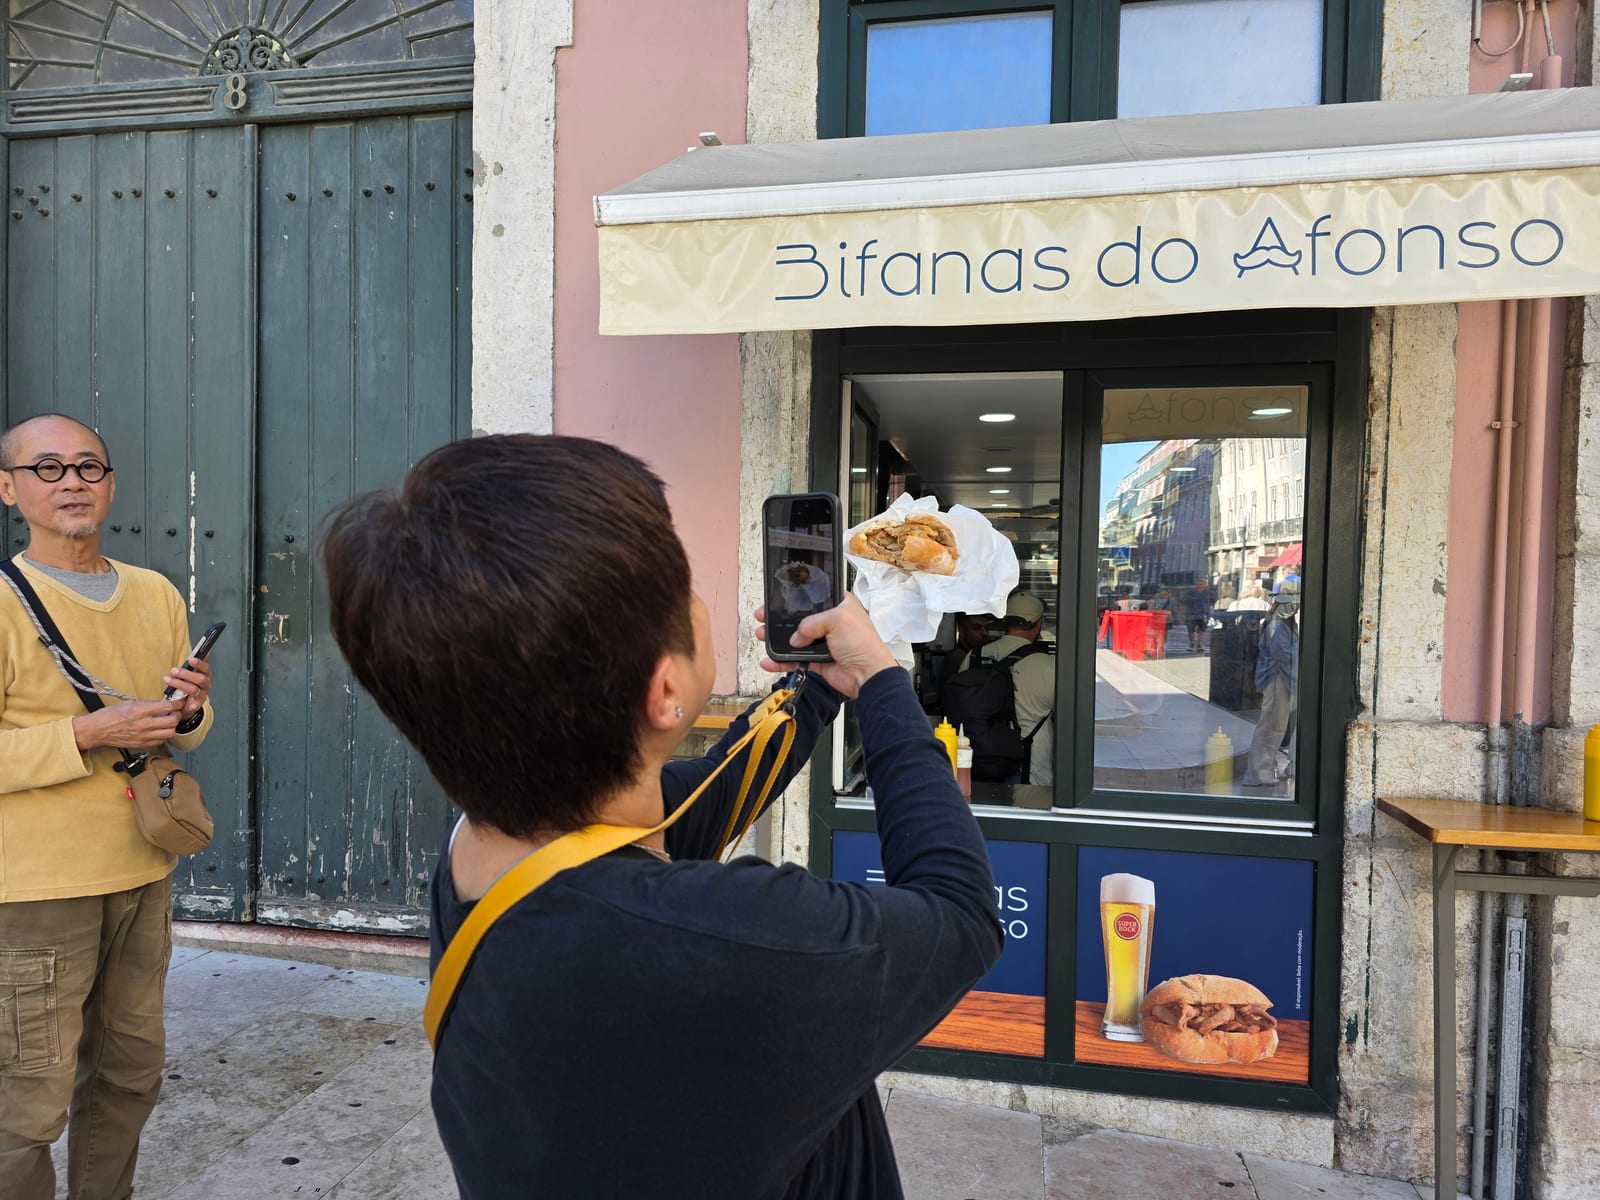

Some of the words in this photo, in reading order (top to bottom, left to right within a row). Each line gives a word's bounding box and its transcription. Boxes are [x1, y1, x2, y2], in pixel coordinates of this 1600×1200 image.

[224, 74, 247, 110] 8
[774, 239, 1071, 302] Bifanas
[1097, 225, 1200, 287] do
[1232, 213, 1565, 280] Afonso
